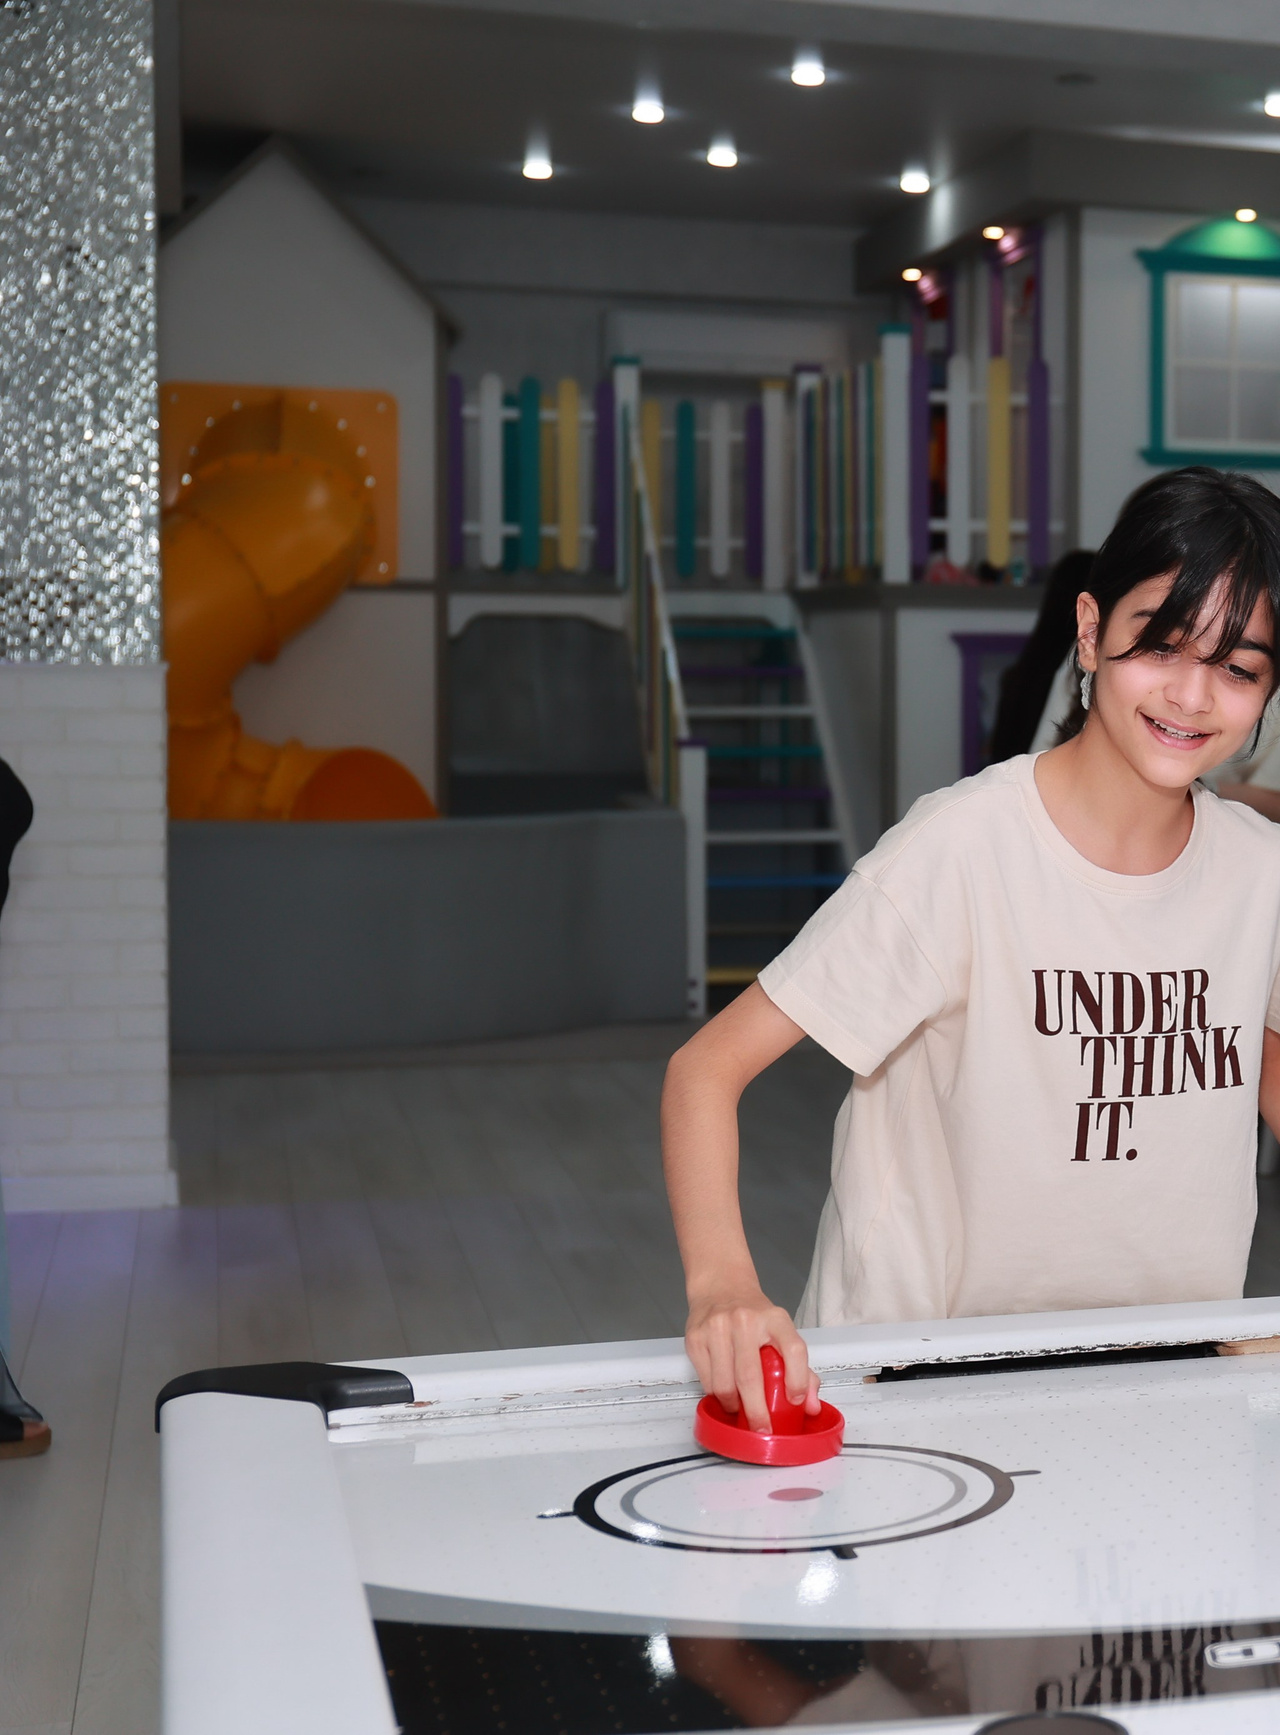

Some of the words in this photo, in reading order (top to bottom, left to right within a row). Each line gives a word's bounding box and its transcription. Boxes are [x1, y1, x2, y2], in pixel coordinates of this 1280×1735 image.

[1031, 968, 1212, 1036] UNDER
[1080, 1025, 1245, 1099] THINK
[1070, 1101, 1138, 1162] IT.
